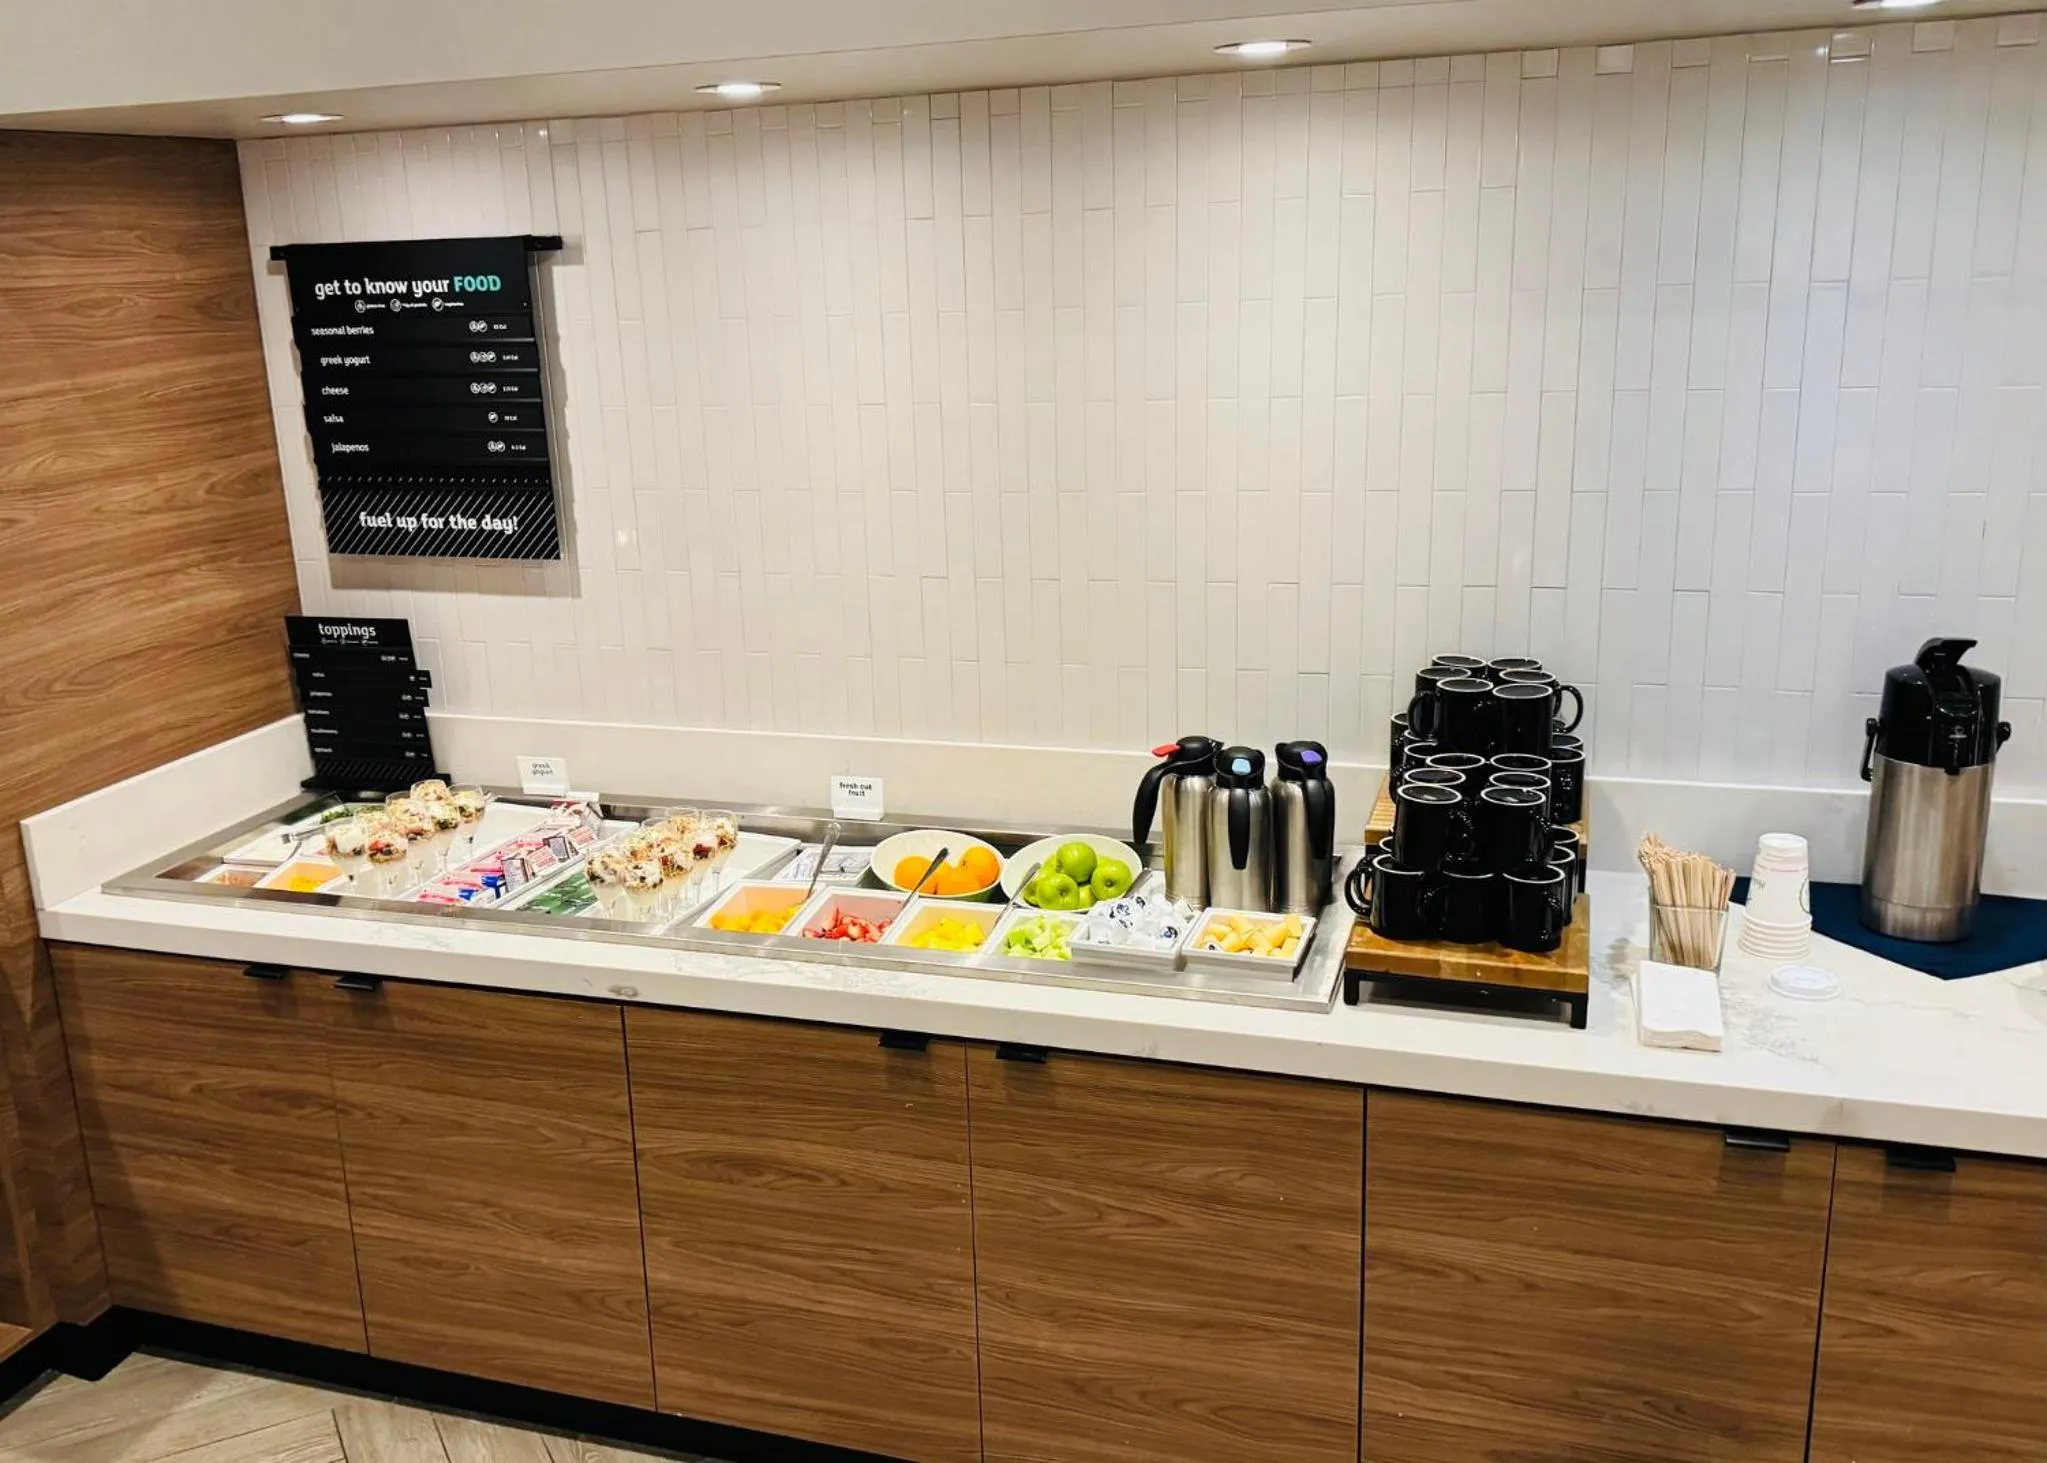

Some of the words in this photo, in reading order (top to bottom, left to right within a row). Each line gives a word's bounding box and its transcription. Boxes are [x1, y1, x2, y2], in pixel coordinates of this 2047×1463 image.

[314, 279, 342, 300] get
[344, 279, 362, 295] to
[364, 277, 408, 295] know
[411, 279, 450, 298] your
[453, 275, 502, 293] FOOD
[311, 325, 346, 336] seasonal
[346, 325, 374, 336] berries
[320, 352, 343, 366] greek
[343, 354, 371, 368] yogurt
[321, 385, 350, 396] cheese
[323, 413, 344, 424] salsa
[359, 511, 393, 528] fuel
[396, 515, 417, 532] up
[420, 513, 445, 530] for
[449, 514, 477, 530] the
[481, 514, 518, 535] day!
[318, 623, 377, 640] toppings
